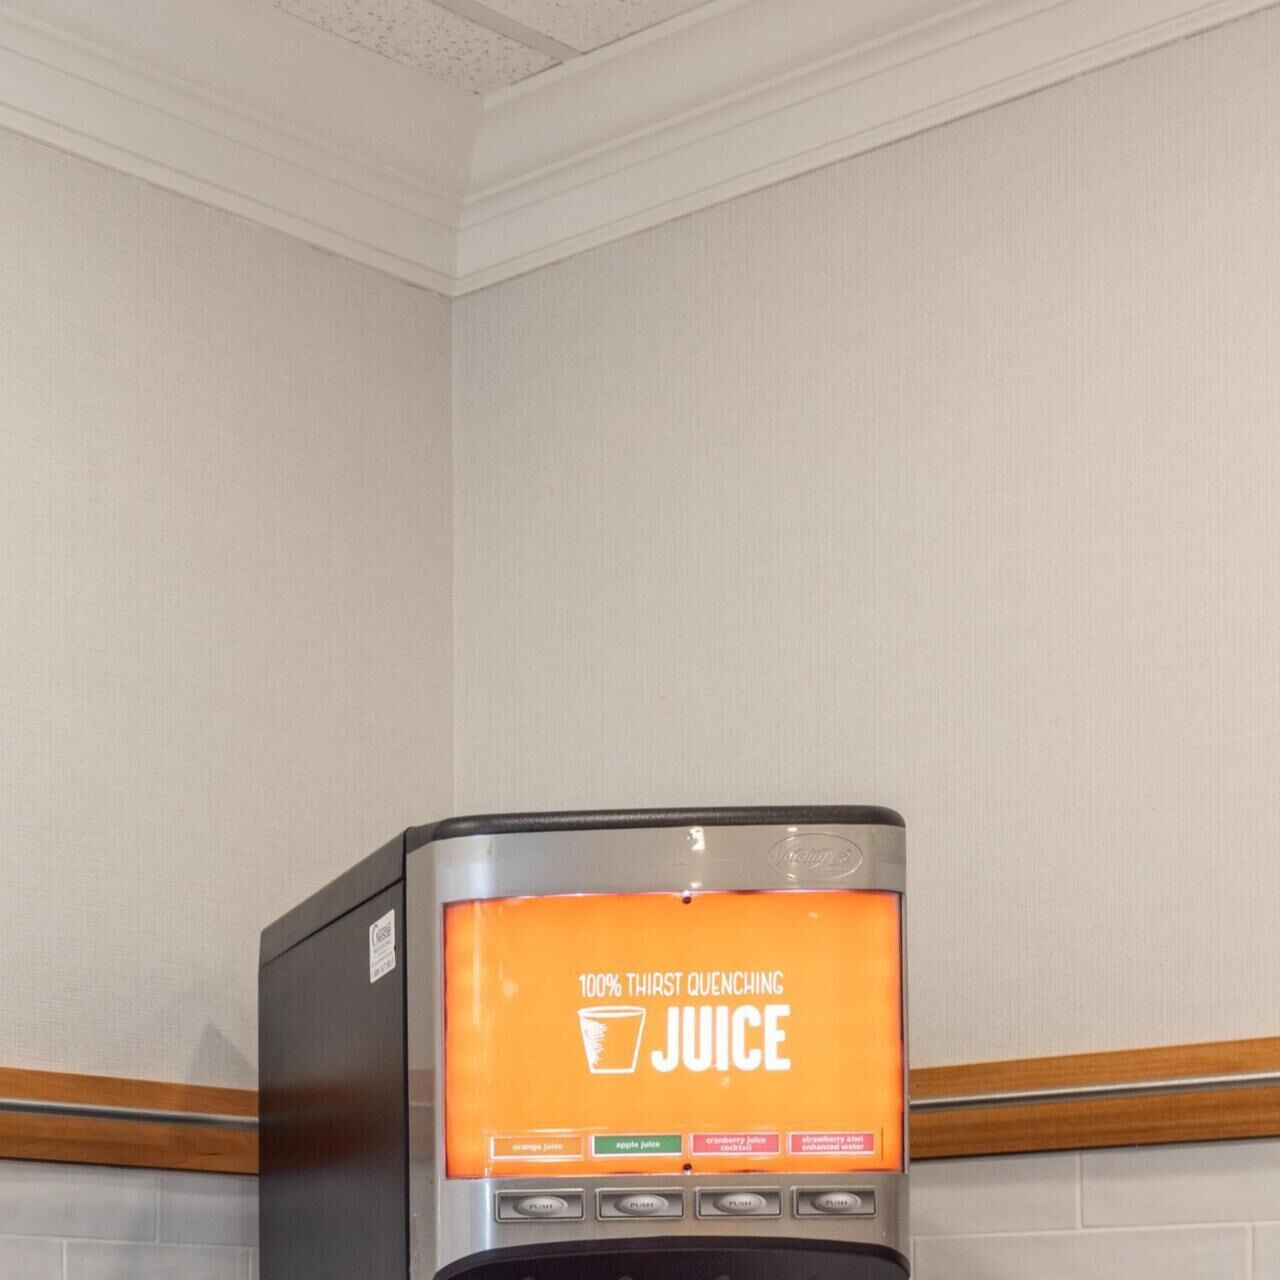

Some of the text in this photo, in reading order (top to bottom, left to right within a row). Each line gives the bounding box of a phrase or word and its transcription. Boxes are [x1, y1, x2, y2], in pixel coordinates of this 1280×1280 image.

[579, 971, 784, 997] 100% THIRST QUENCHING
[651, 1004, 792, 1072] JUICE
[616, 1140, 660, 1149] apple juice
[706, 1136, 766, 1145] cranberry juice
[512, 1142, 564, 1152] orange juice
[720, 1144, 752, 1152] cocktail
